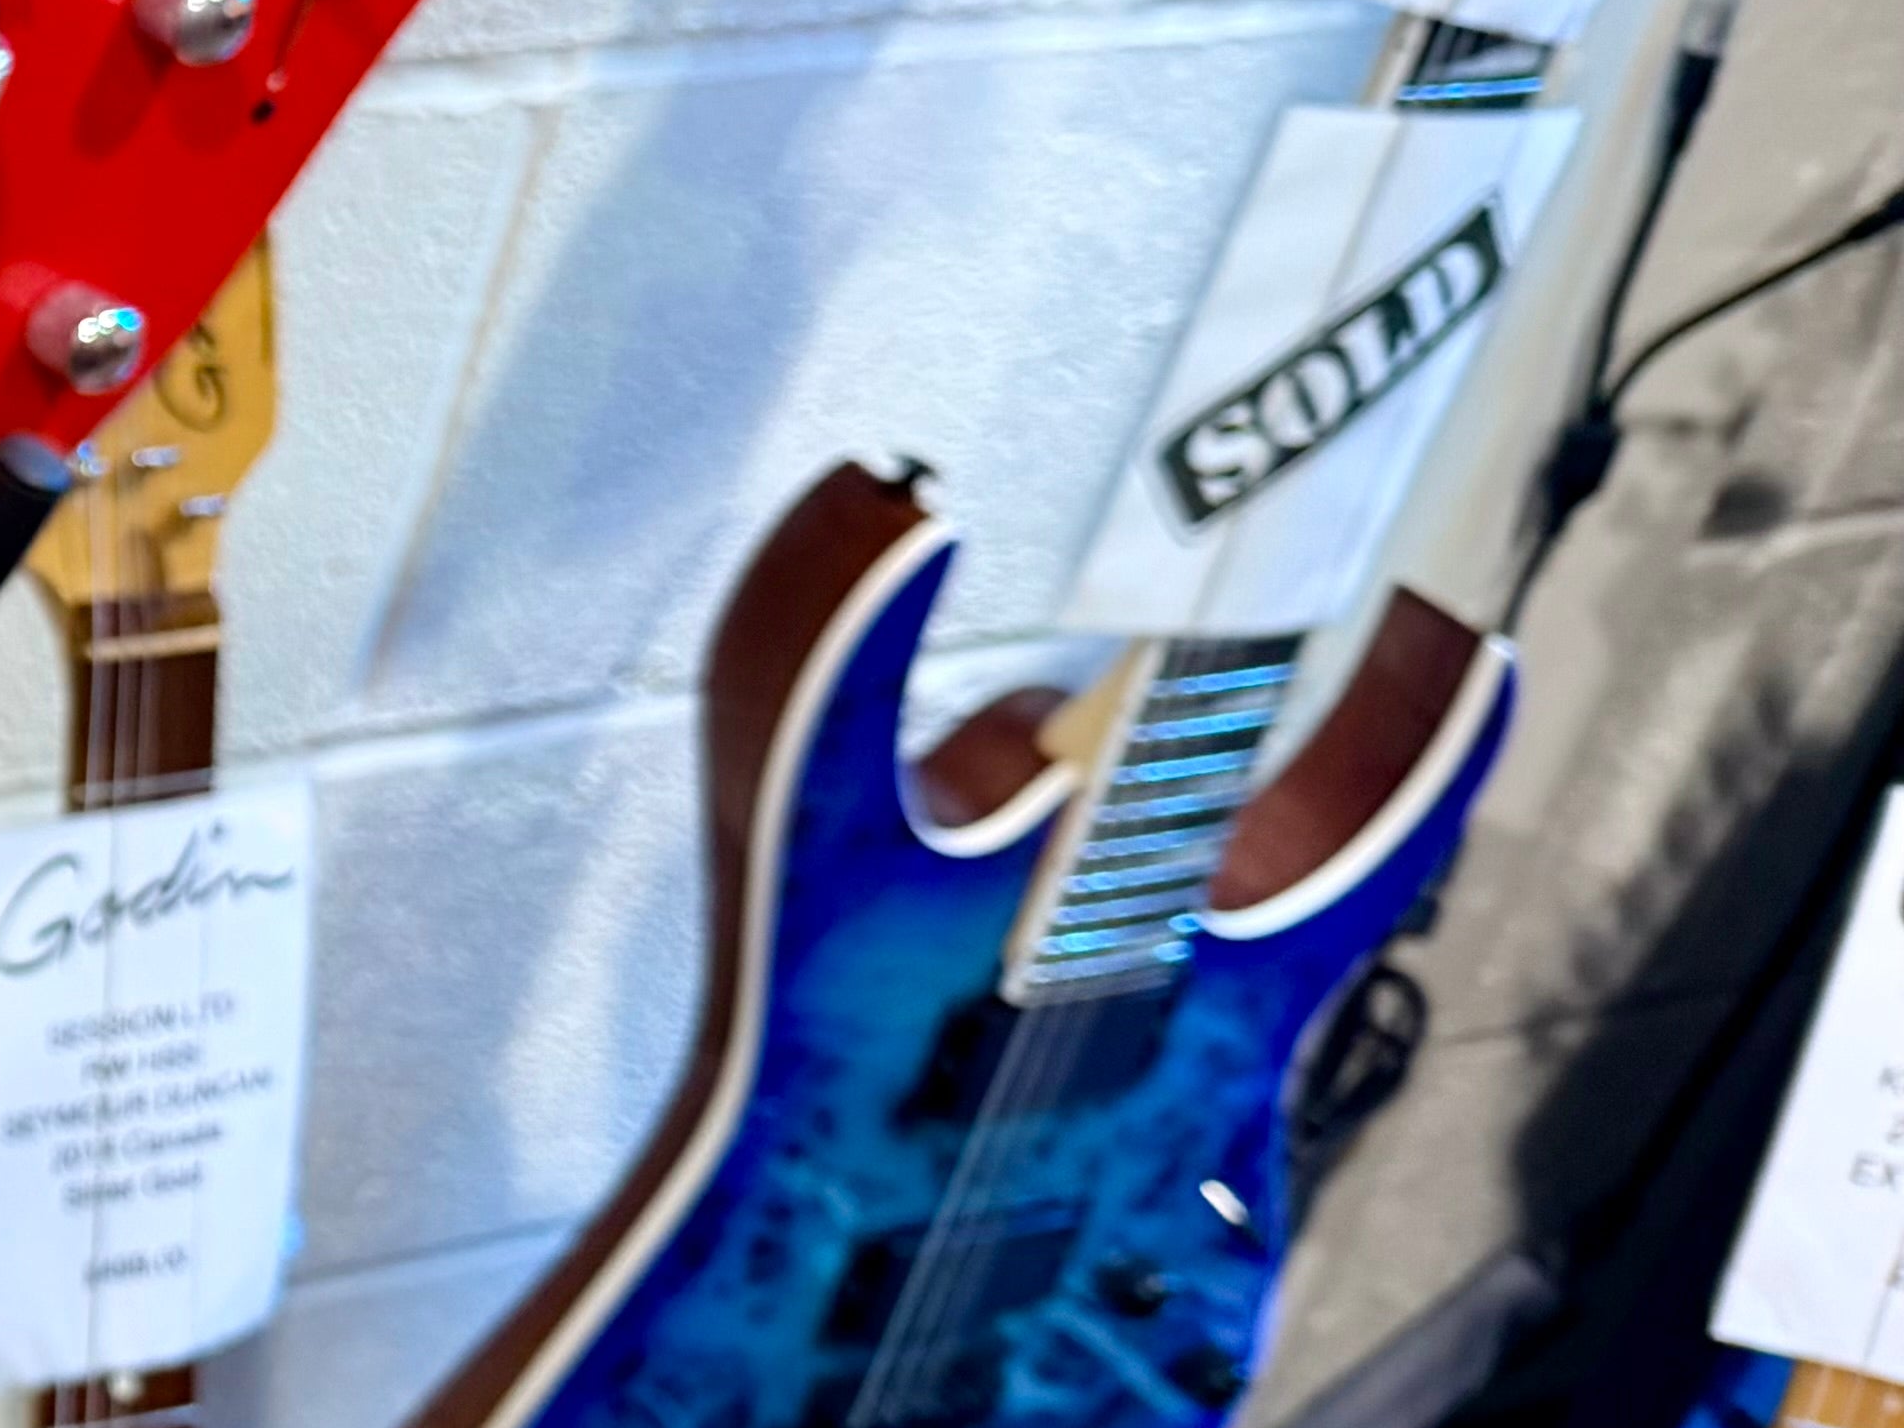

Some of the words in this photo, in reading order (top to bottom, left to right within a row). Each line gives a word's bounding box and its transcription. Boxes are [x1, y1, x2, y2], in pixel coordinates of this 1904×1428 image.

[1185, 237, 1495, 504] SOLD
[0, 1086, 149, 1147] SEYMOUR
[153, 1066, 274, 1116] DUNCAN
